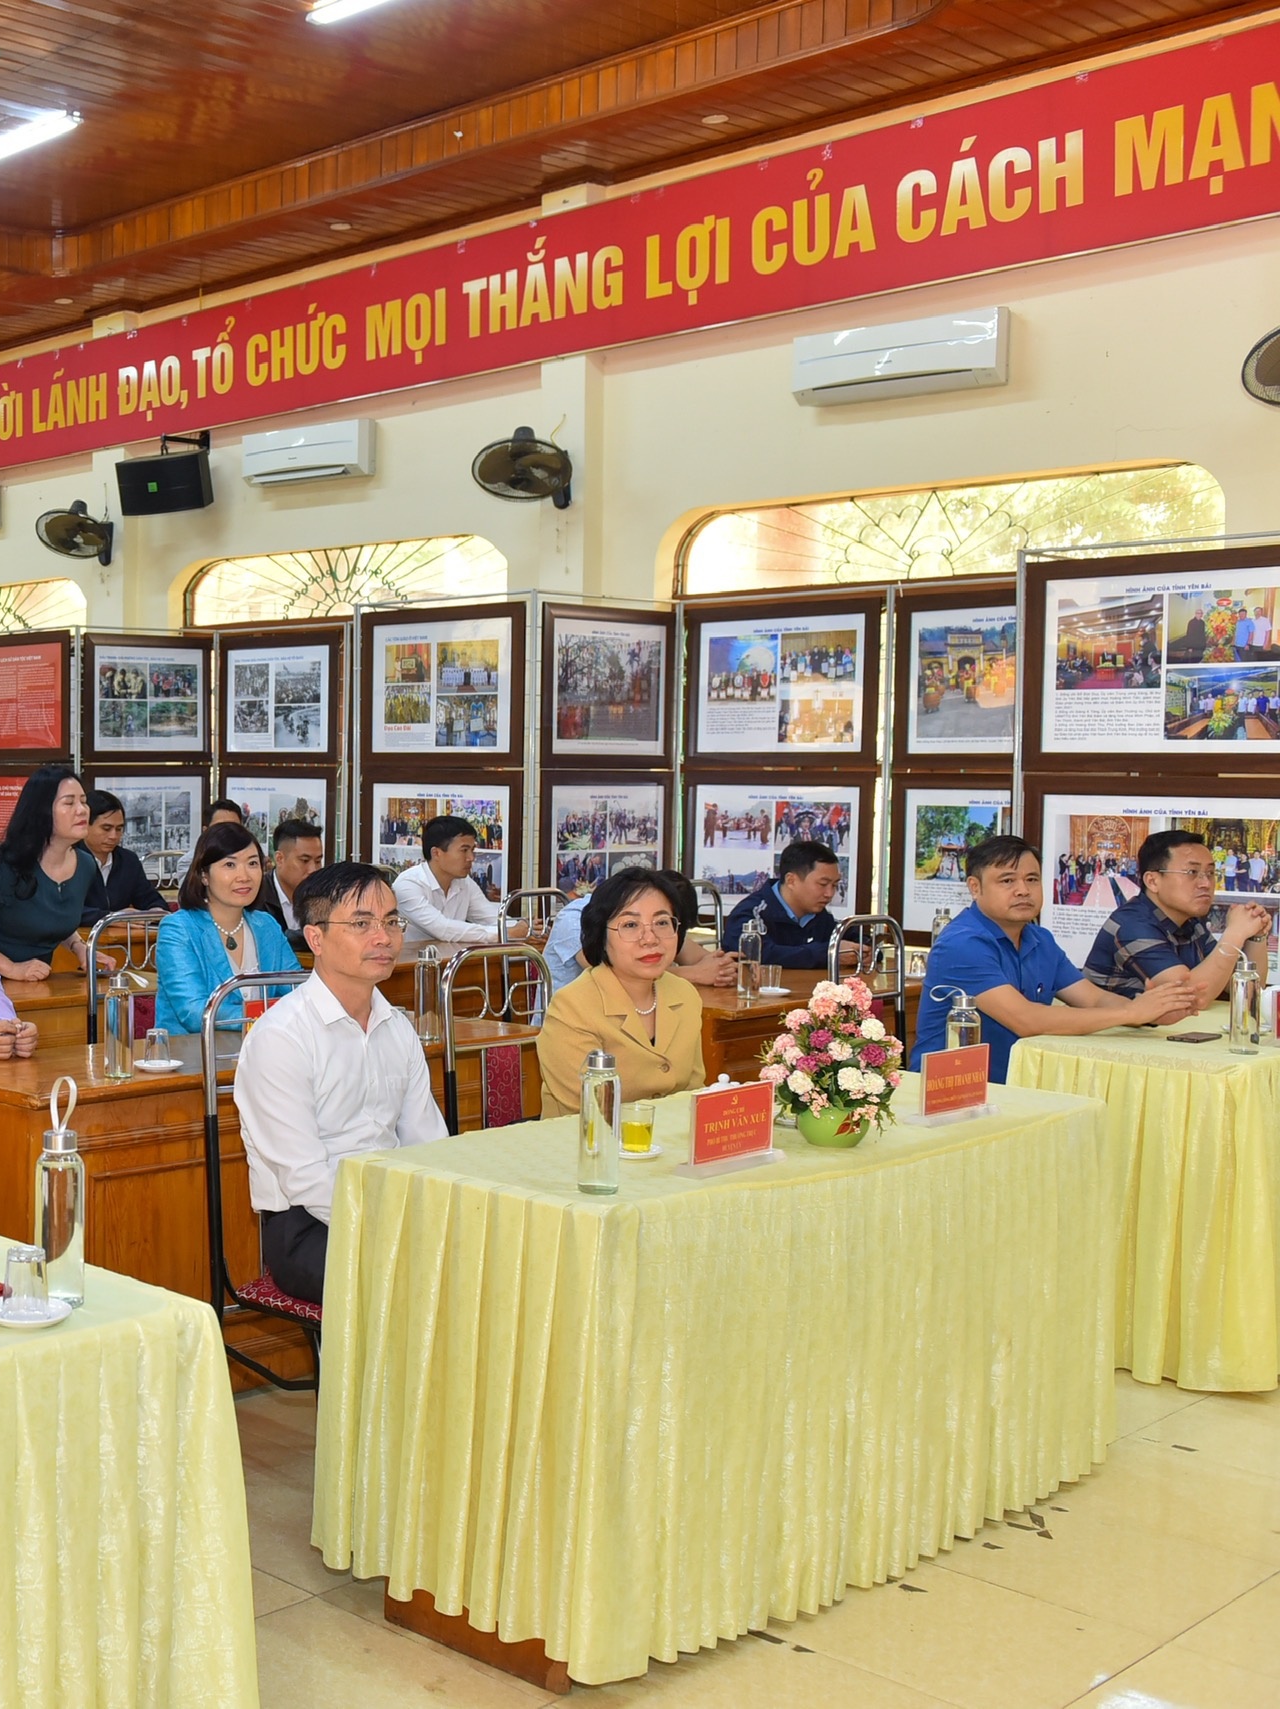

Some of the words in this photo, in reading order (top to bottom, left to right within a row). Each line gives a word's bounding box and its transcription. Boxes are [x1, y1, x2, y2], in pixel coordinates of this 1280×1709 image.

[246, 303, 348, 388] CHỨC
[365, 287, 447, 365] MỌI
[462, 235, 624, 339] THẮNG
[645, 214, 731, 306] LỢI
[751, 167, 877, 276] CỦA
[895, 135, 1084, 244] CÁCH
[704, 1119, 730, 1134] TRỊNH
[732, 1115, 748, 1128] VĂN
